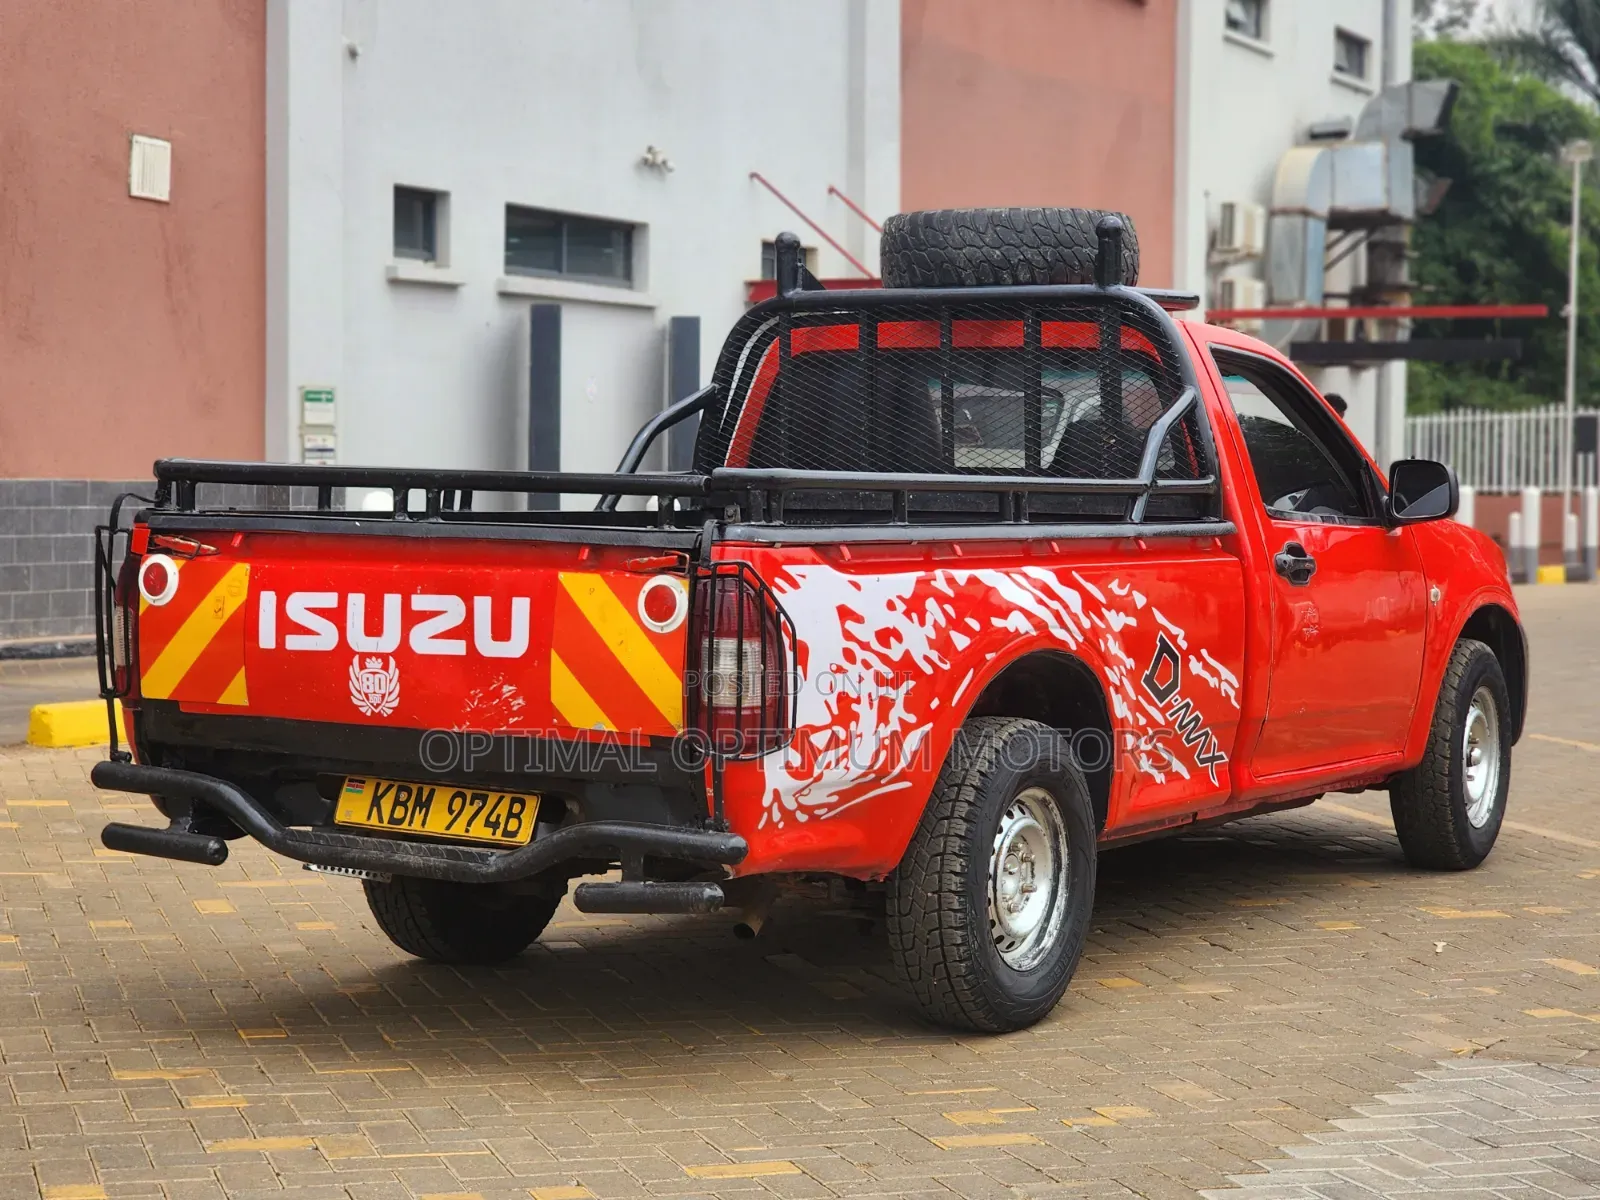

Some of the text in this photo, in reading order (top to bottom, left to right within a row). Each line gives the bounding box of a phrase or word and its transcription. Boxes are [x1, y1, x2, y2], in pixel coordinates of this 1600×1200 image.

[259, 591, 530, 658] ISUZU
[362, 673, 387, 694] 80
[366, 781, 527, 839] KBM 974B
